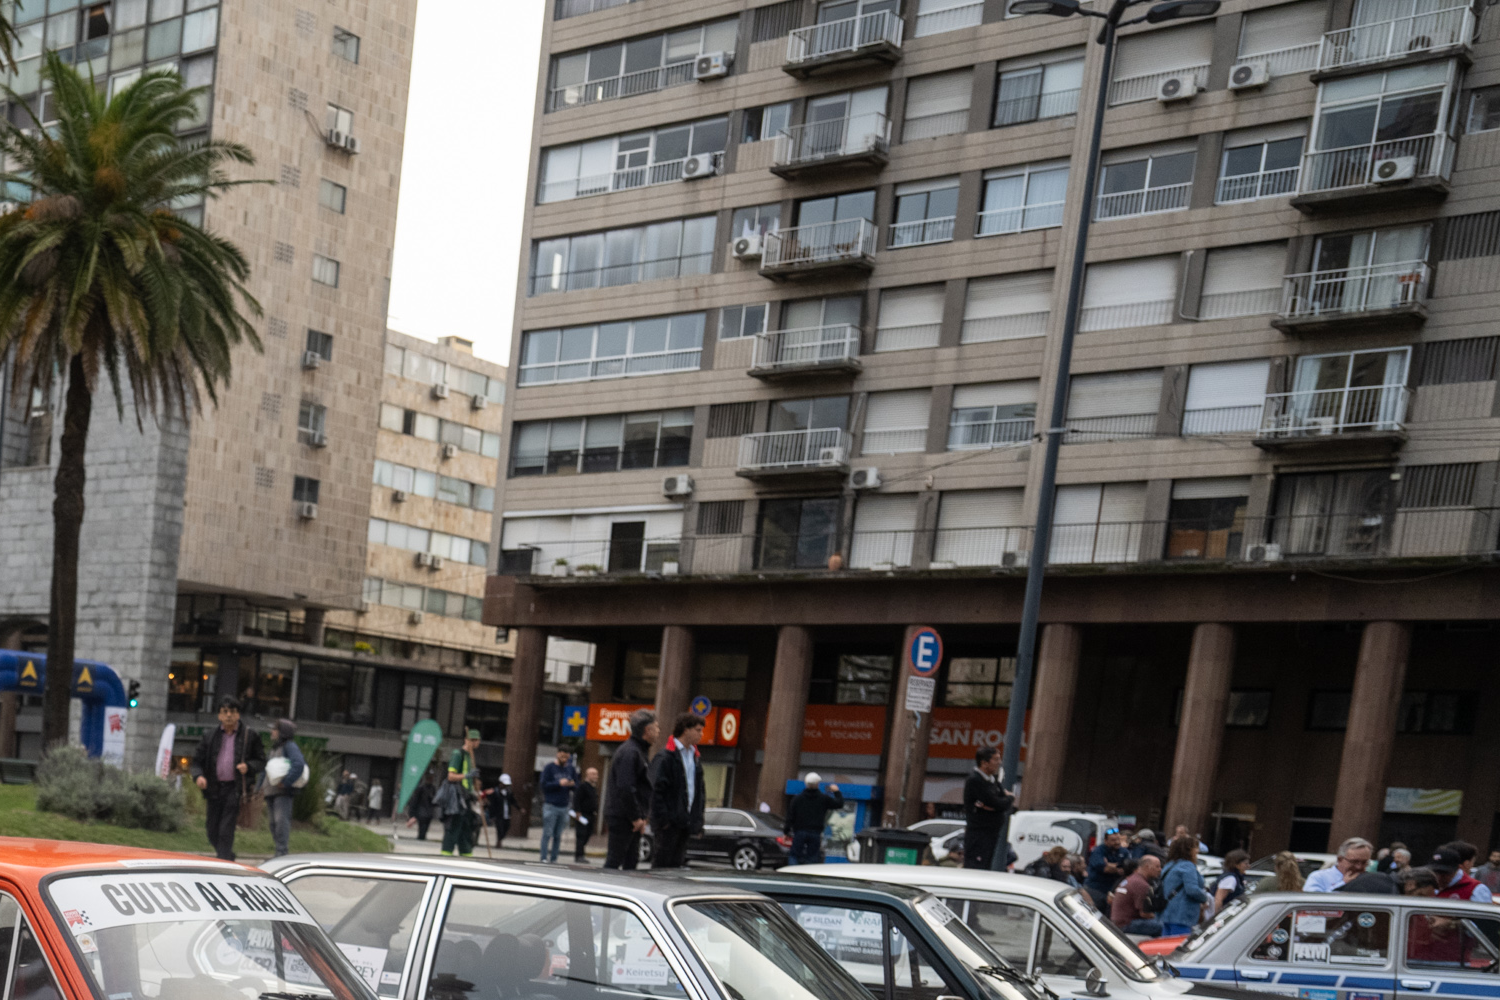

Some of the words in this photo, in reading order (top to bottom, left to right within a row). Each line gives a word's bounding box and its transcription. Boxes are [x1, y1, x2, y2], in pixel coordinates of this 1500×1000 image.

[916, 635, 935, 669] E
[929, 727, 970, 746] SAN
[1027, 832, 1064, 845] SILDAN
[100, 880, 202, 917] CULTO
[194, 881, 243, 912] AL
[226, 882, 301, 916] RALLY
[626, 966, 665, 977] Keiretsu
